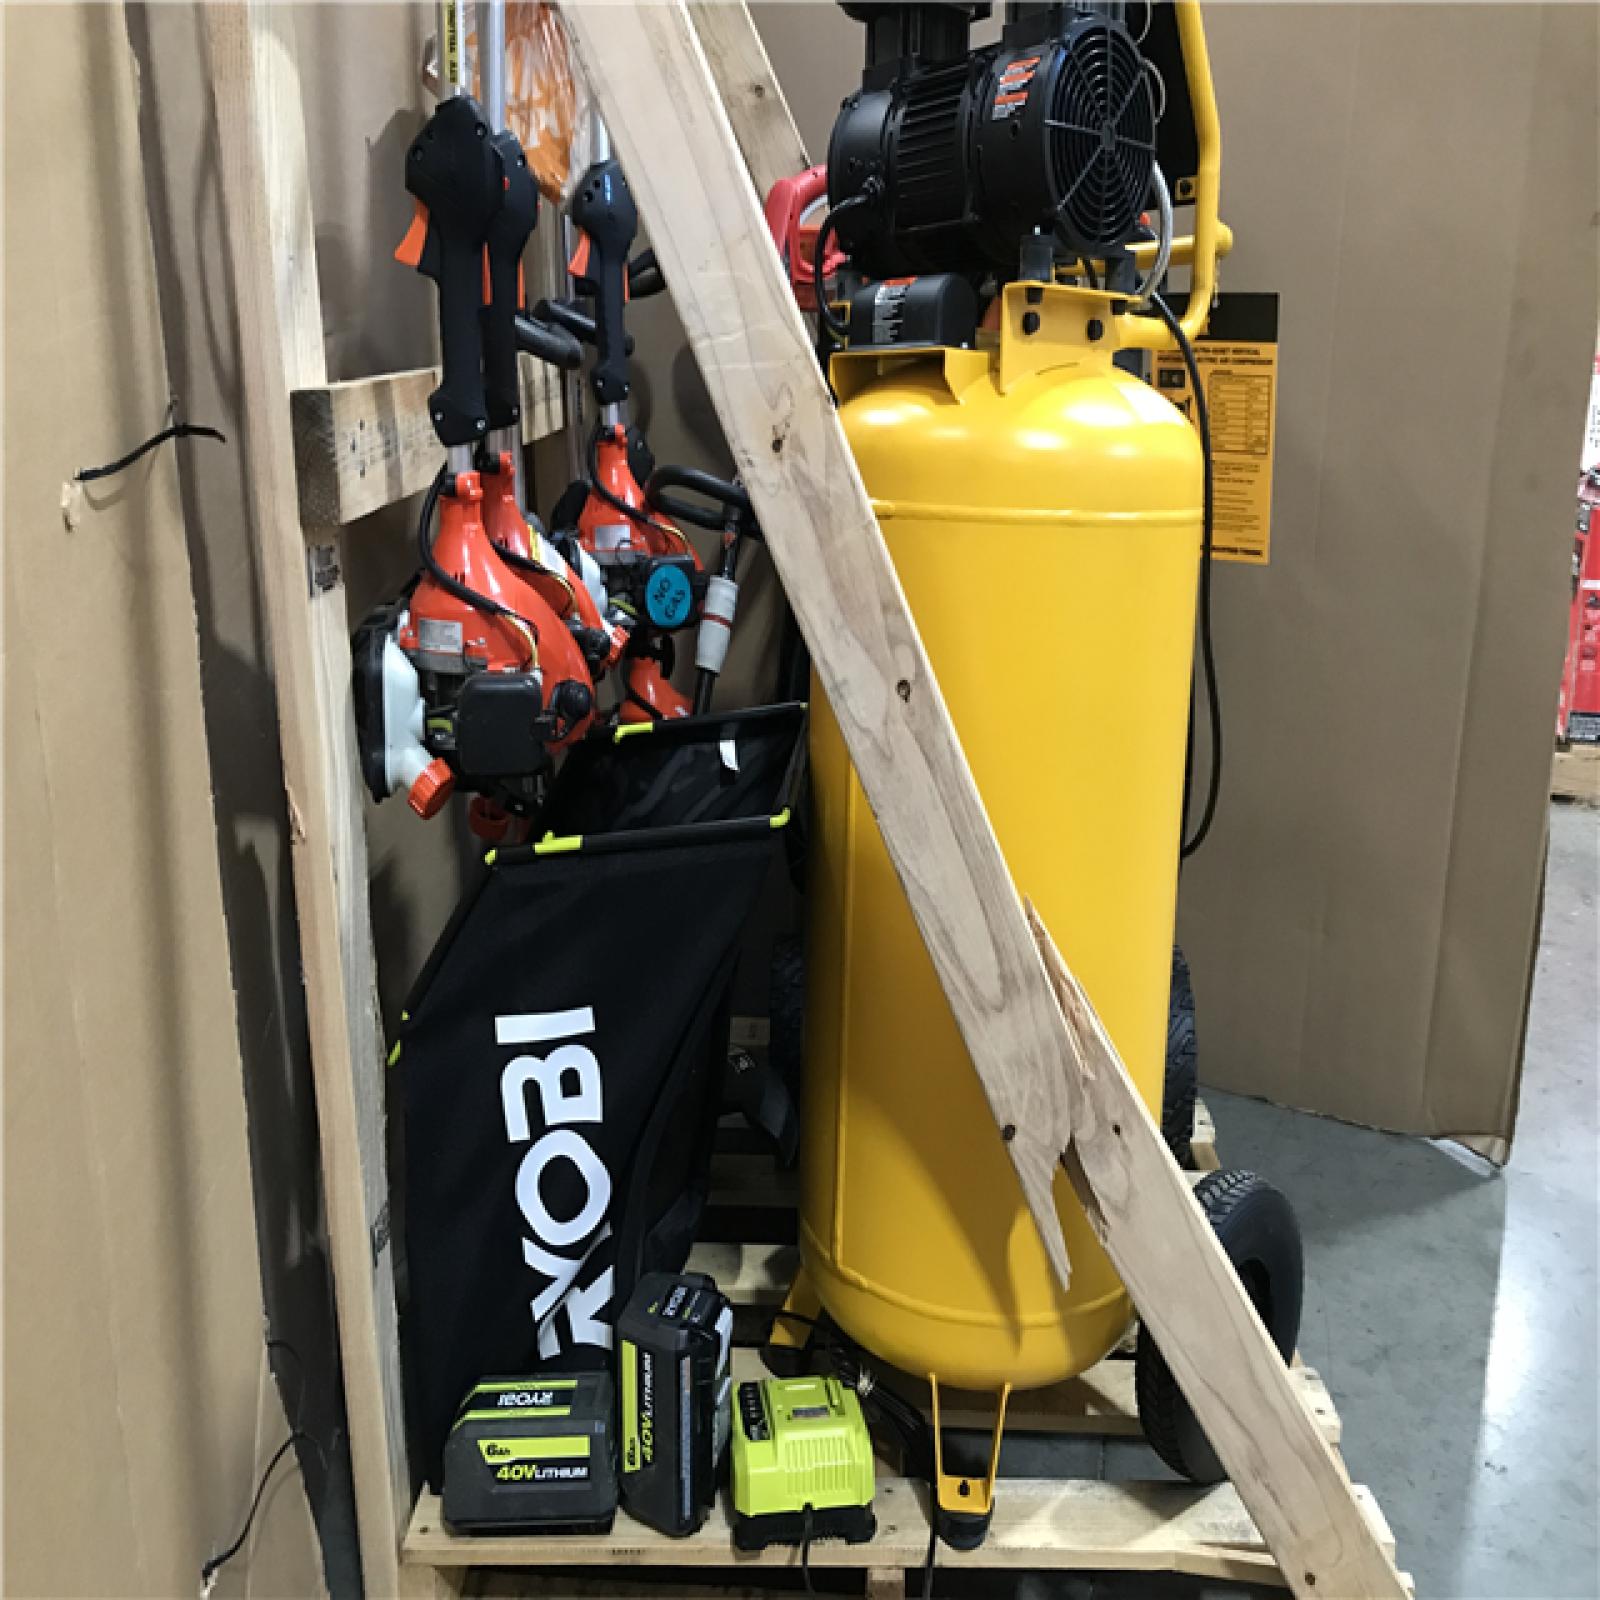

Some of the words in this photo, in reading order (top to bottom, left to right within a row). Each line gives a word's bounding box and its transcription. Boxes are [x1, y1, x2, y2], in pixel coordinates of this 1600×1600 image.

[653, 577, 671, 603] NO
[664, 588, 686, 619] GAS
[495, 1005, 615, 1362] RYOBI
[497, 1391, 554, 1406] RYOBI
